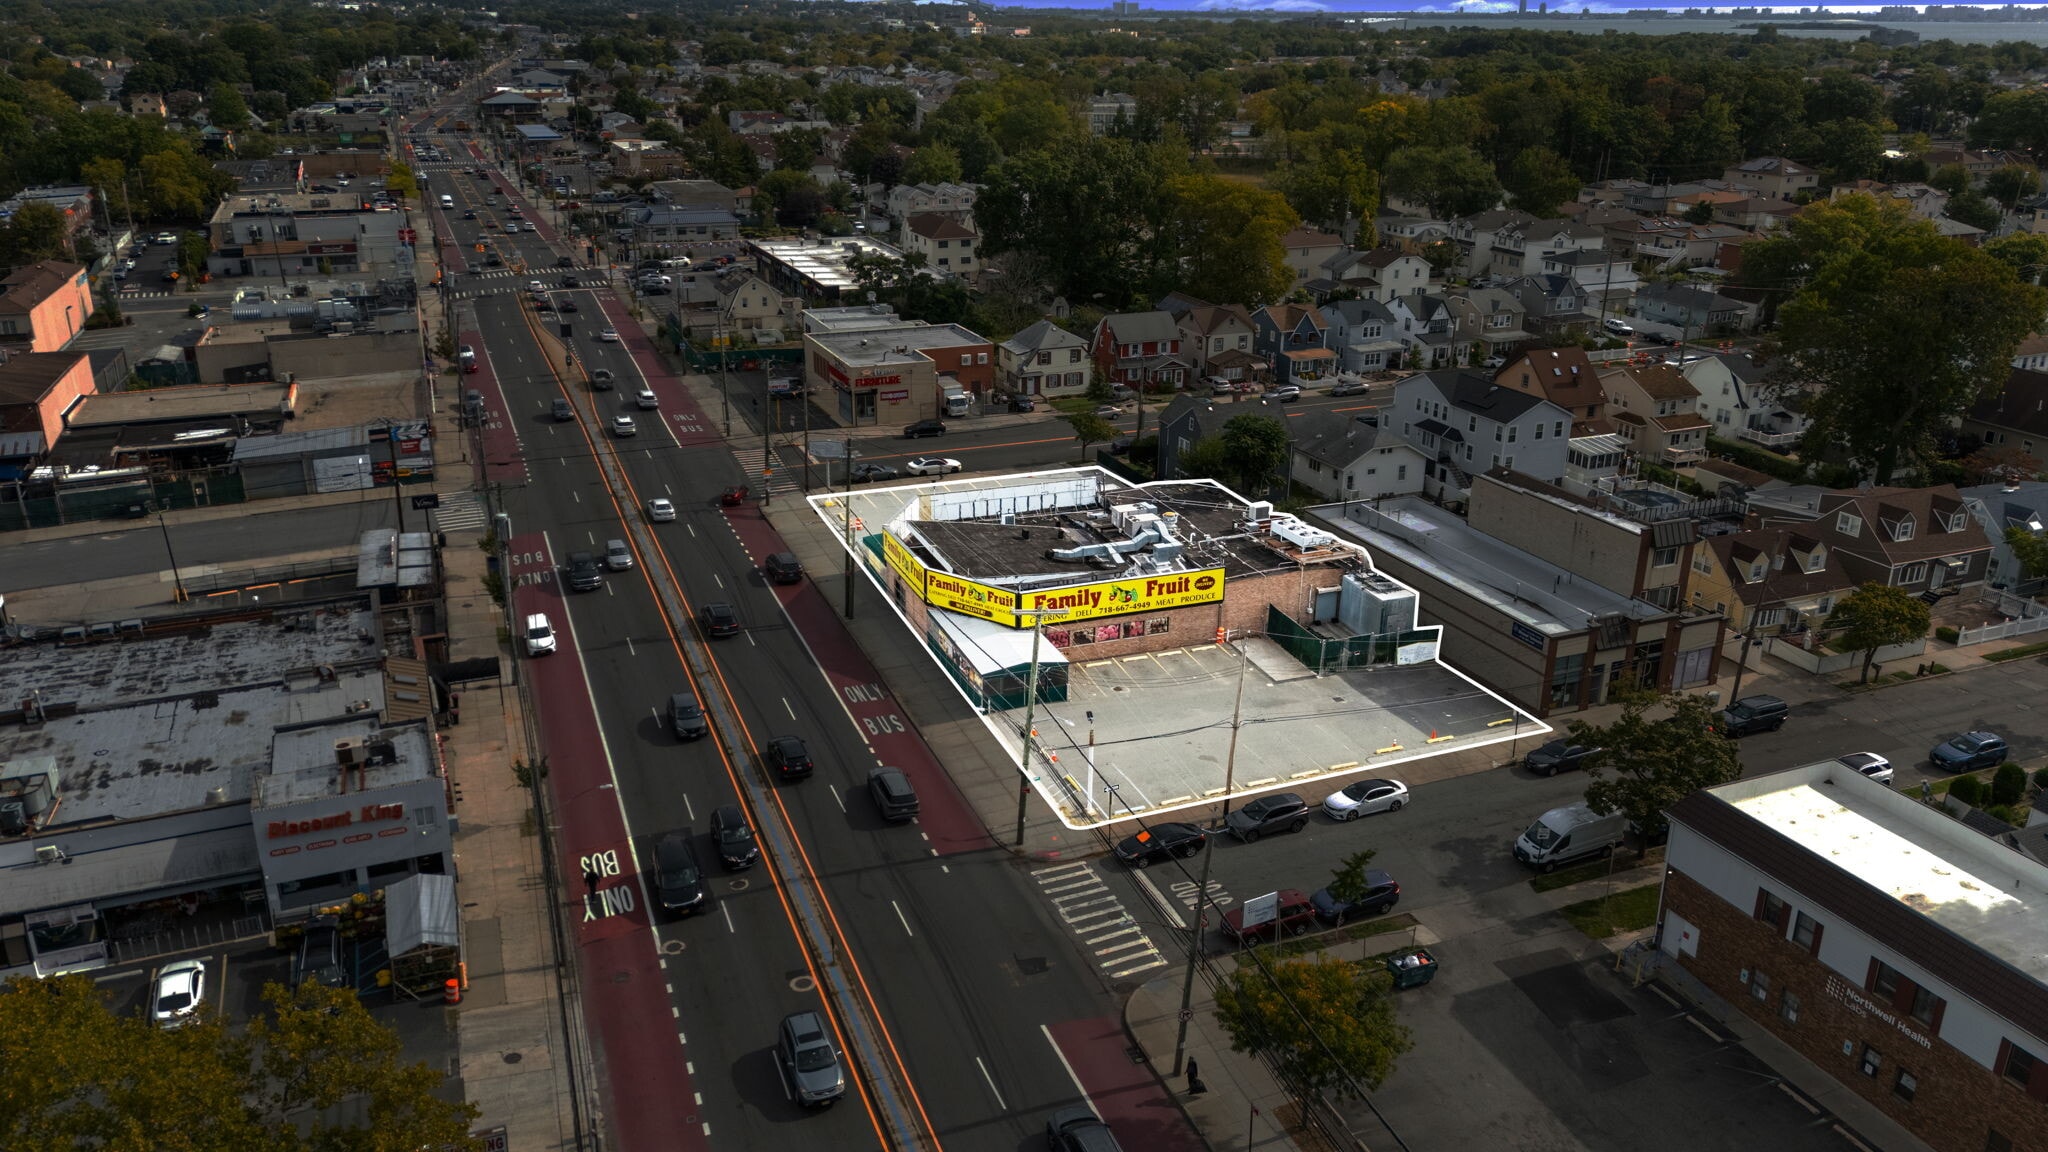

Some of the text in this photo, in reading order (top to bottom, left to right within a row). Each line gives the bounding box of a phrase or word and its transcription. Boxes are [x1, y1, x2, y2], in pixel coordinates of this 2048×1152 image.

[855, 375, 902, 387] FURNITURE
[680, 425, 704, 433] BUS
[512, 551, 544, 566] BUS
[518, 571, 551, 587] ONLY
[929, 575, 1014, 607] Family Fruit
[1034, 577, 1190, 609] Family Fruit
[1076, 609, 1092, 618] DELI
[1099, 602, 1151, 614] 718-667-4949
[1156, 598, 1175, 607] MEAT
[1180, 592, 1216, 603] PRODUCE
[844, 683, 885, 703] ONLY
[862, 714, 905, 736] BUS
[268, 810, 352, 839] Discount
[361, 803, 404, 822] King
[580, 849, 620, 879] BUS
[582, 885, 635, 922] ONLY
[1844, 997, 1867, 1019] Labs
[1846, 987, 1931, 1049] Northwell Health
